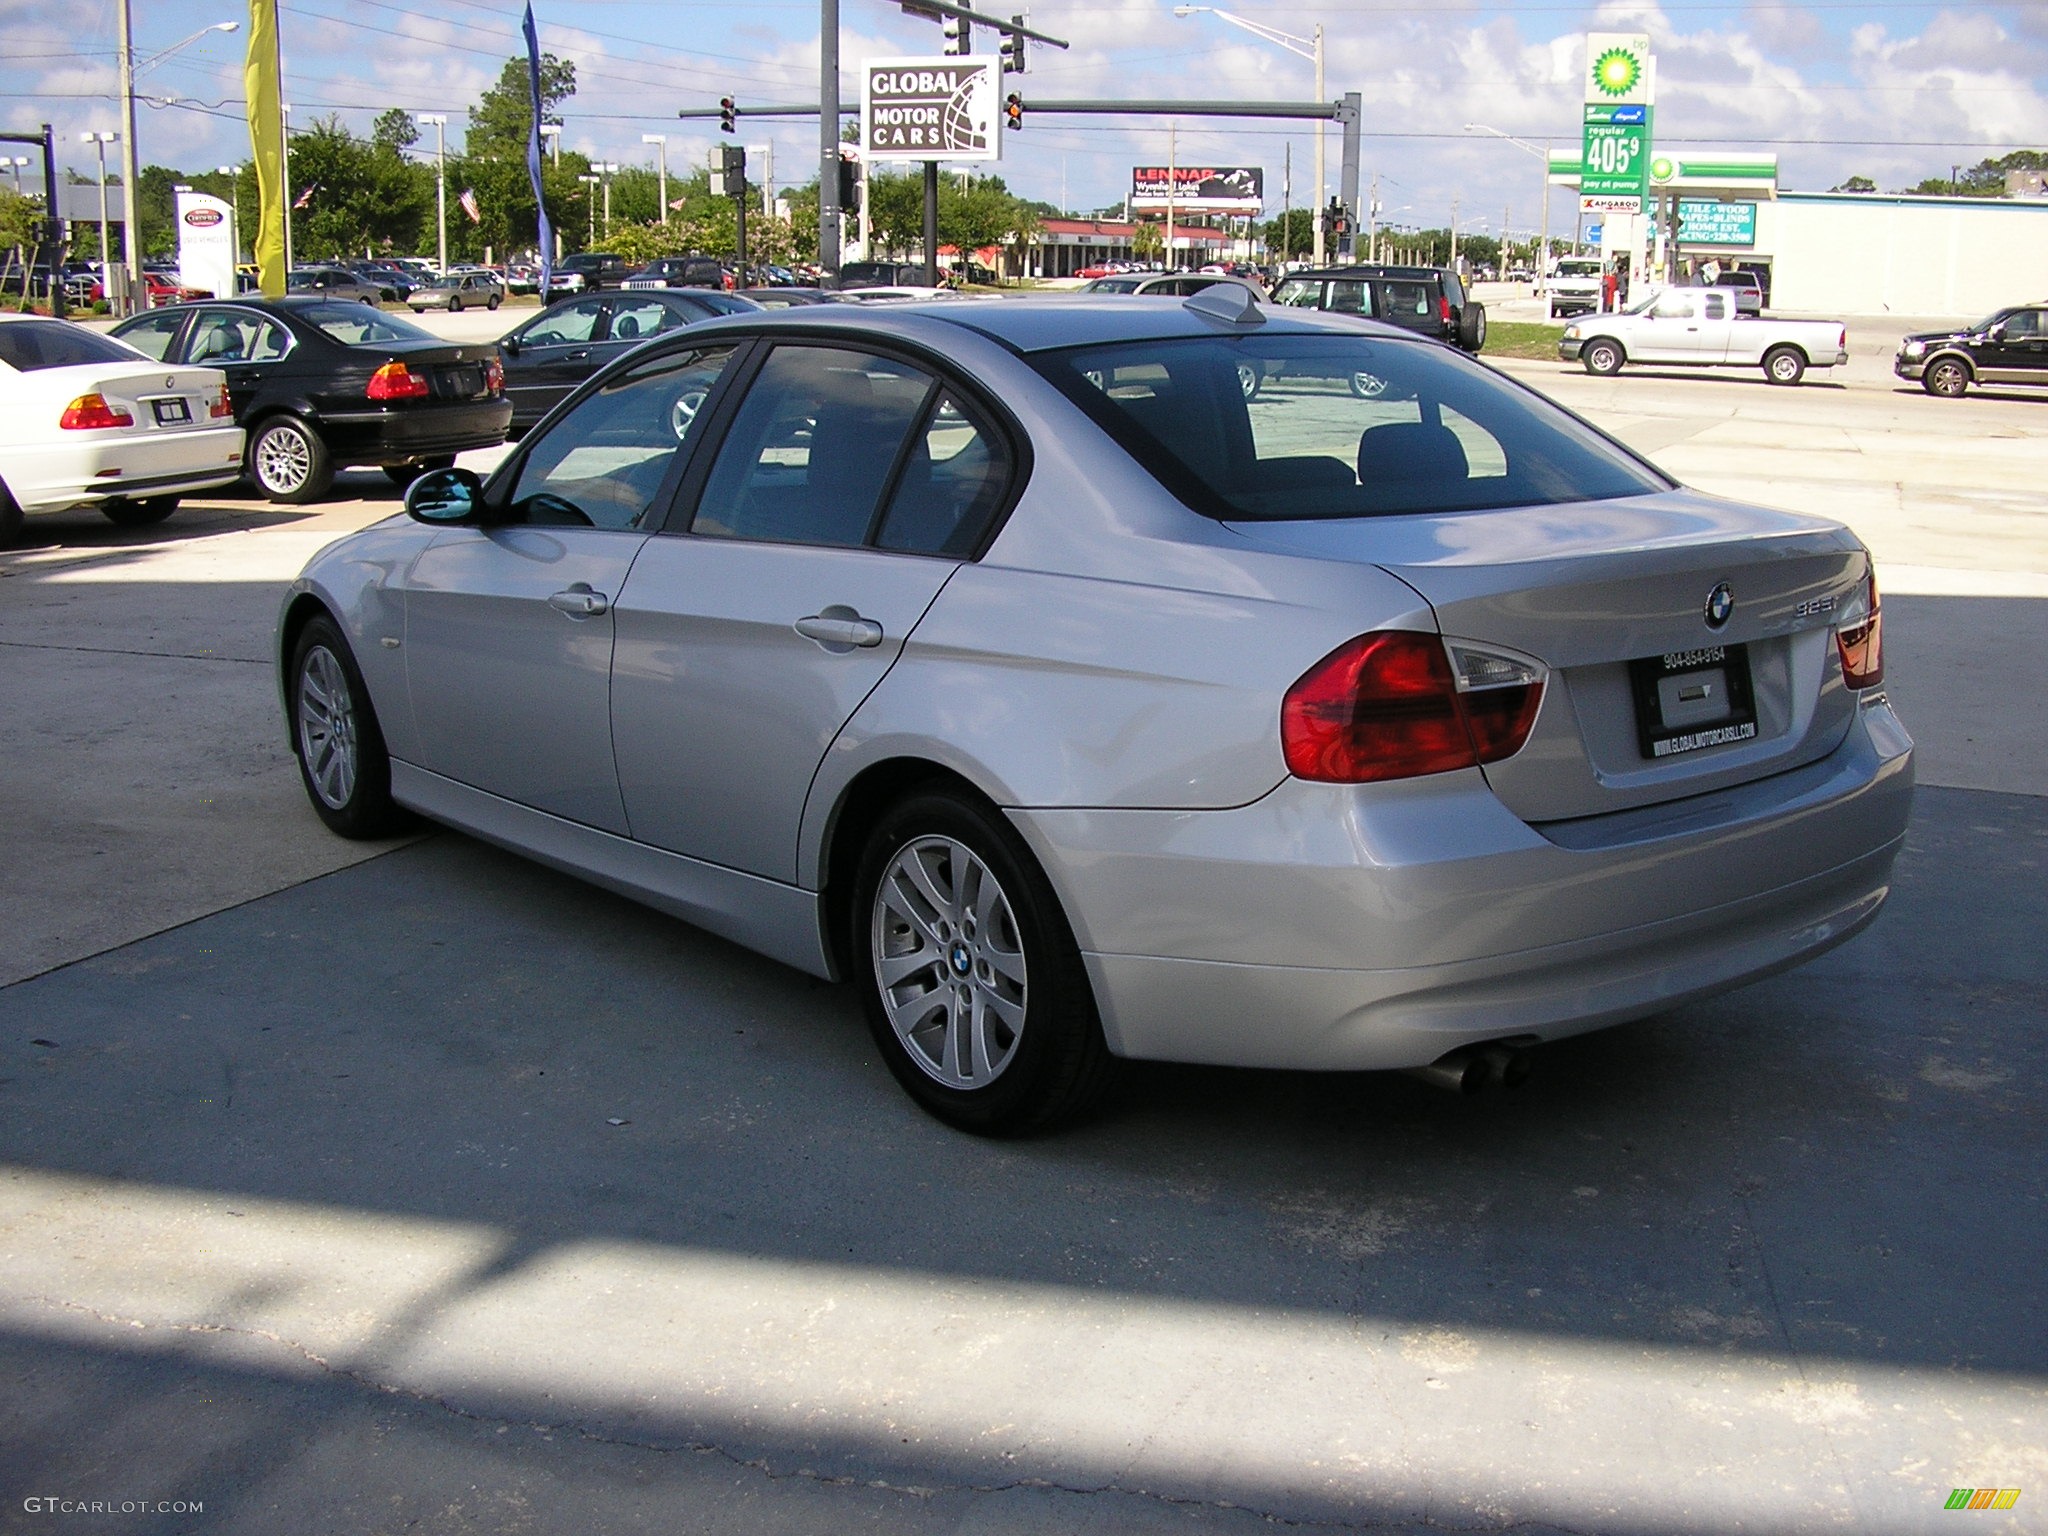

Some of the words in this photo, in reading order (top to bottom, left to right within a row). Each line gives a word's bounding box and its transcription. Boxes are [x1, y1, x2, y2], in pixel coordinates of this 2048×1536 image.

[1633, 39, 1647, 50] bp
[872, 72, 958, 94] GLOBAL
[874, 108, 940, 125] MOTOR
[873, 128, 940, 145] CARS
[1588, 127, 1626, 136] regular
[1136, 169, 1216, 181] LENNAR
[1178, 181, 1200, 191] Lakes
[1583, 181, 1600, 189] pay
[1612, 181, 1639, 190] pump
[1583, 199, 1638, 207] KANGAROO
[1687, 203, 1710, 213] TILE
[1716, 205, 1750, 215] WOOD
[1687, 222, 1718, 232] HOME
[1663, 646, 1725, 669] 904-854-9154
